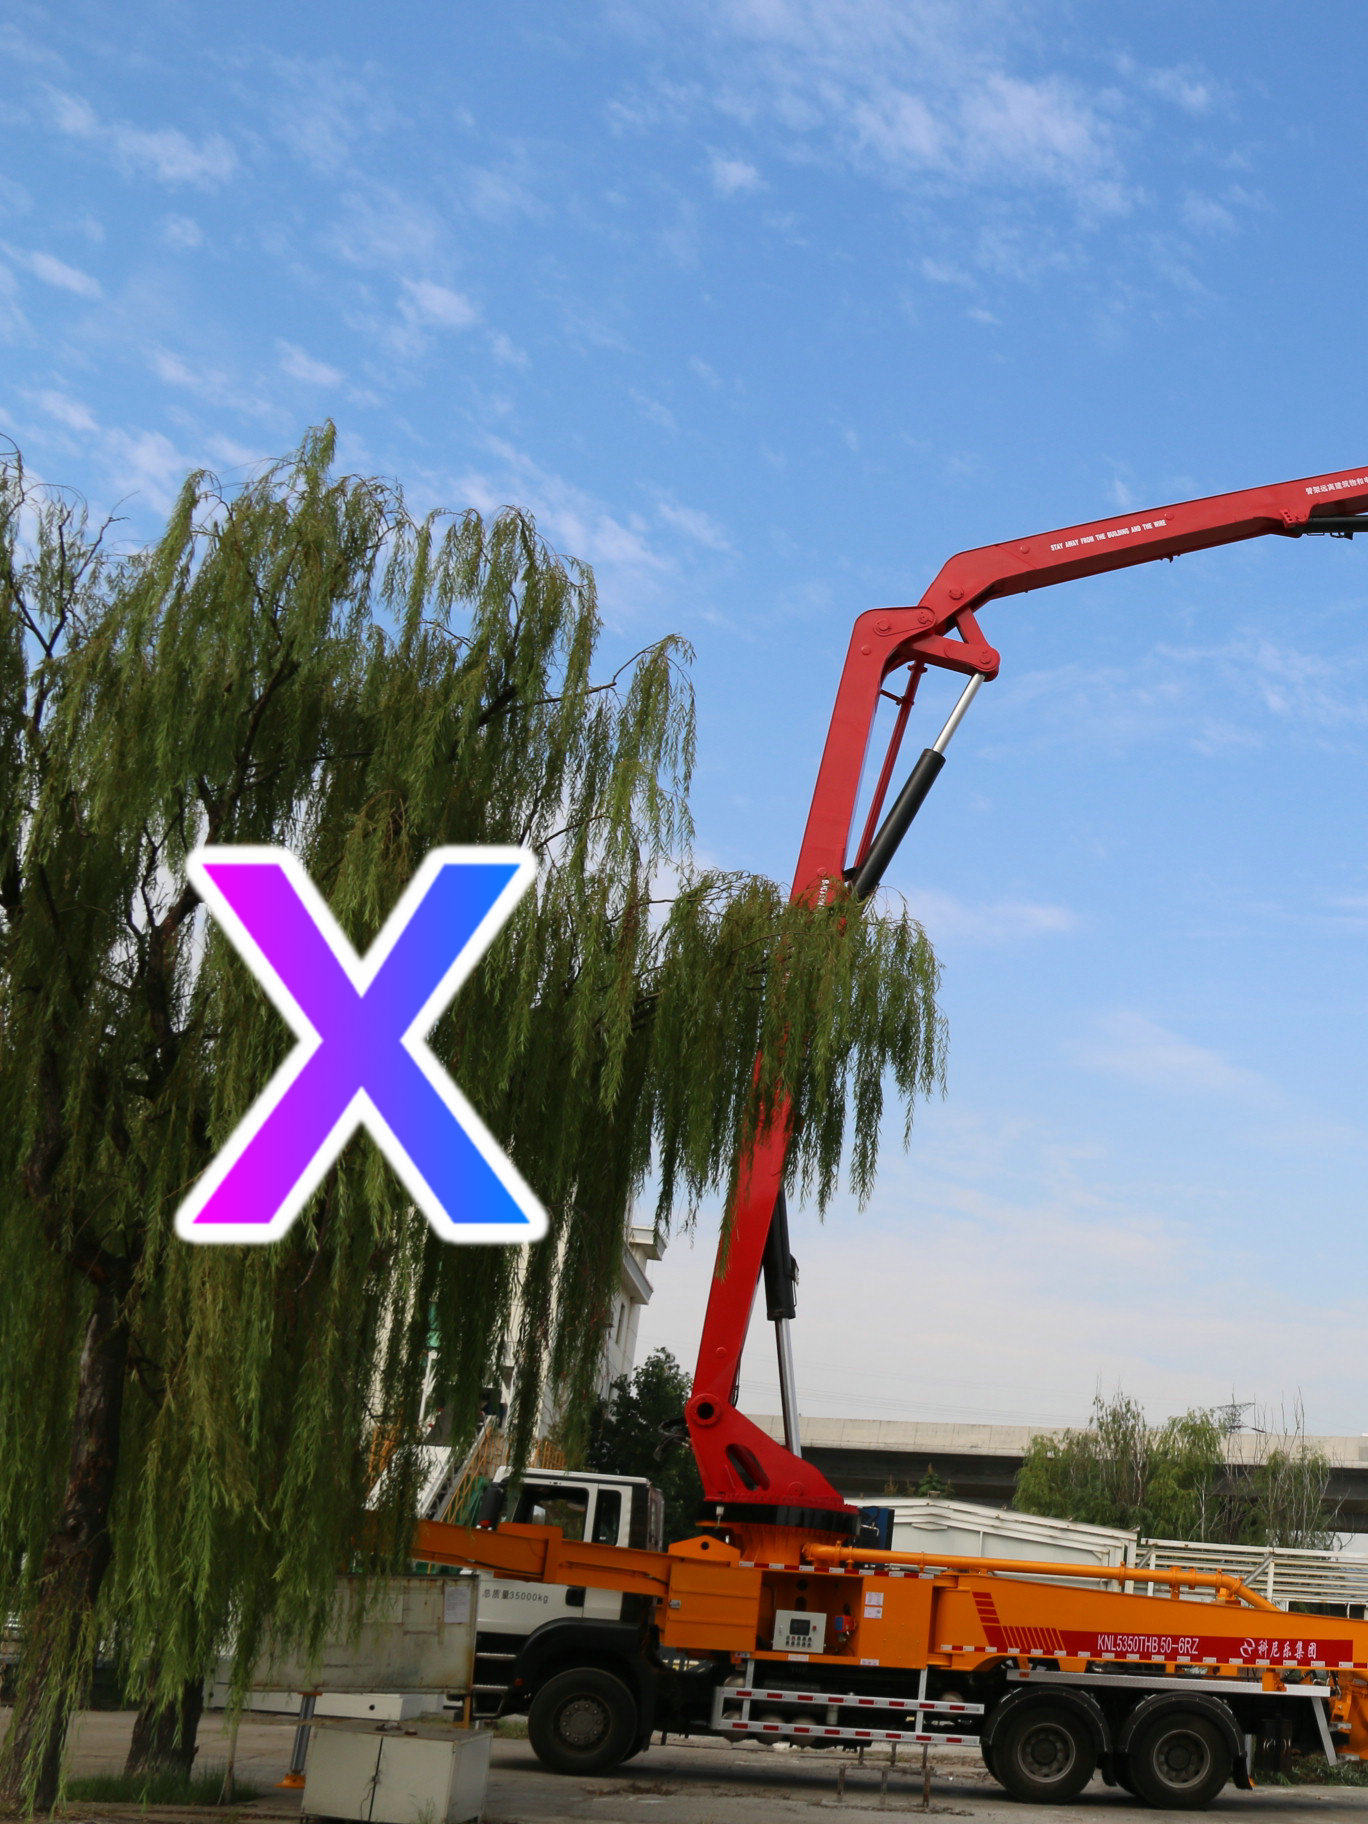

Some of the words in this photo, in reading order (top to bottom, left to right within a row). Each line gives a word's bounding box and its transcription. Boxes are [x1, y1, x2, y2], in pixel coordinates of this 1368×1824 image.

[1050, 542, 1063, 551] STAY
[1065, 538, 1079, 548] AWAY
[1080, 535, 1094, 545] FROM
[1095, 533, 1106, 541] THE
[1107, 527, 1130, 538] BUILDING
[1131, 525, 1141, 533] AND
[1142, 522, 1153, 531] THE
[1153, 519, 1166, 528] WIRE
